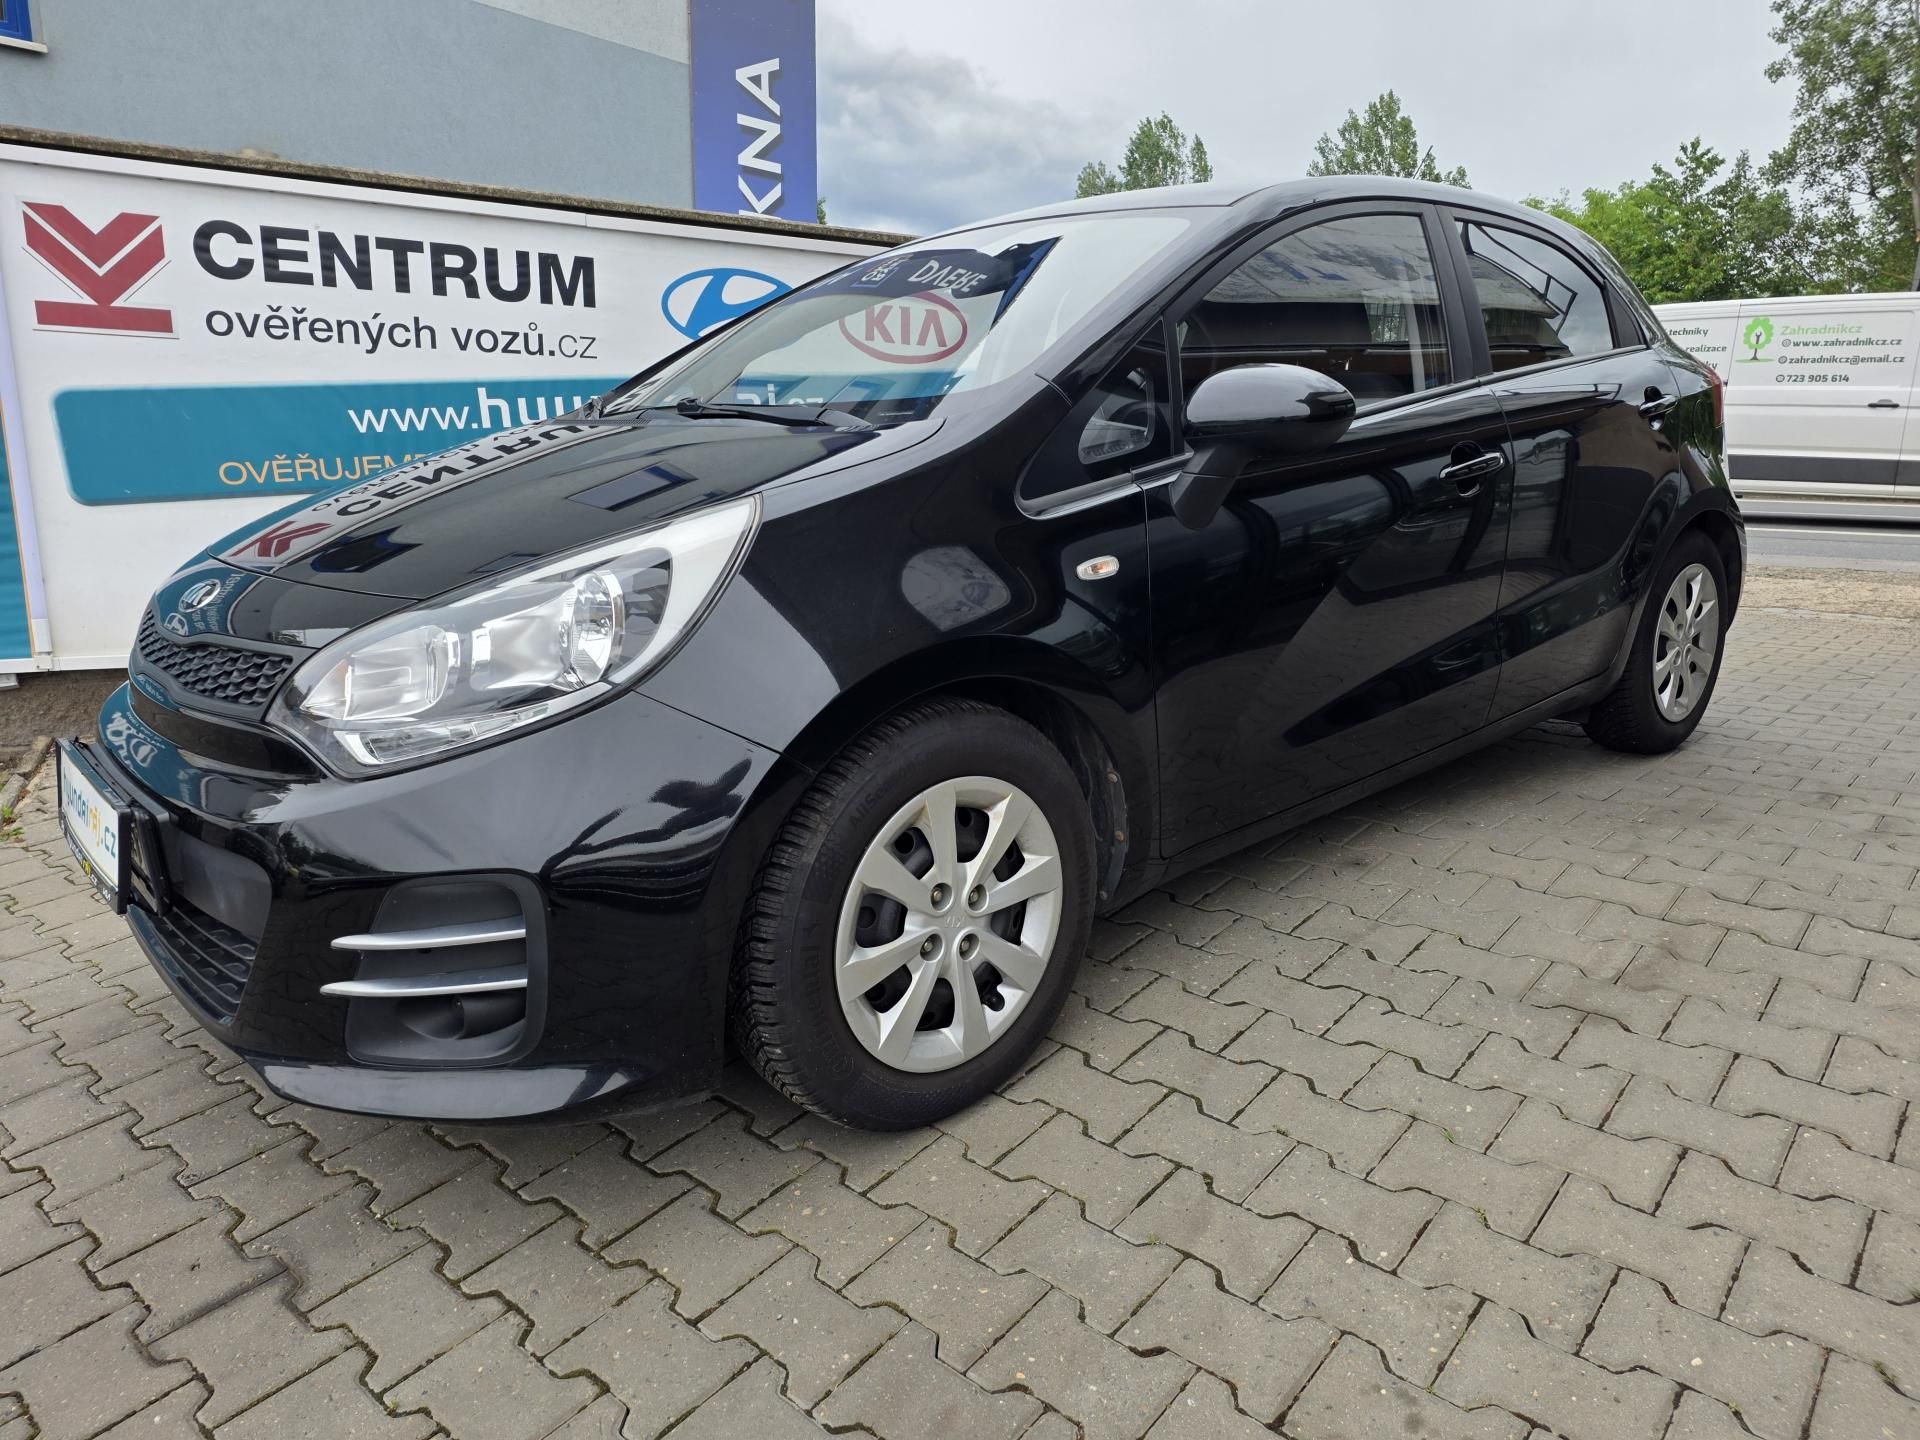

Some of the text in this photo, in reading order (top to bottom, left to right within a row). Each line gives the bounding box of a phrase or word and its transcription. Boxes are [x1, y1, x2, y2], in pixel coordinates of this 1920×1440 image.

[192, 219, 598, 309] CENTRUM
[865, 304, 948, 348] KIA
[1781, 323, 1864, 336] Zahradnikcz
[205, 305, 599, 360] ověřených vozů.cz
[1668, 327, 1709, 338] techniky
[1686, 344, 1727, 353] realizace
[1792, 337, 1903, 348] www.zahradnikcz.cz
[1788, 354, 1906, 366] zahradnikcz@email.cz
[1786, 374, 1850, 383] 723 905 614
